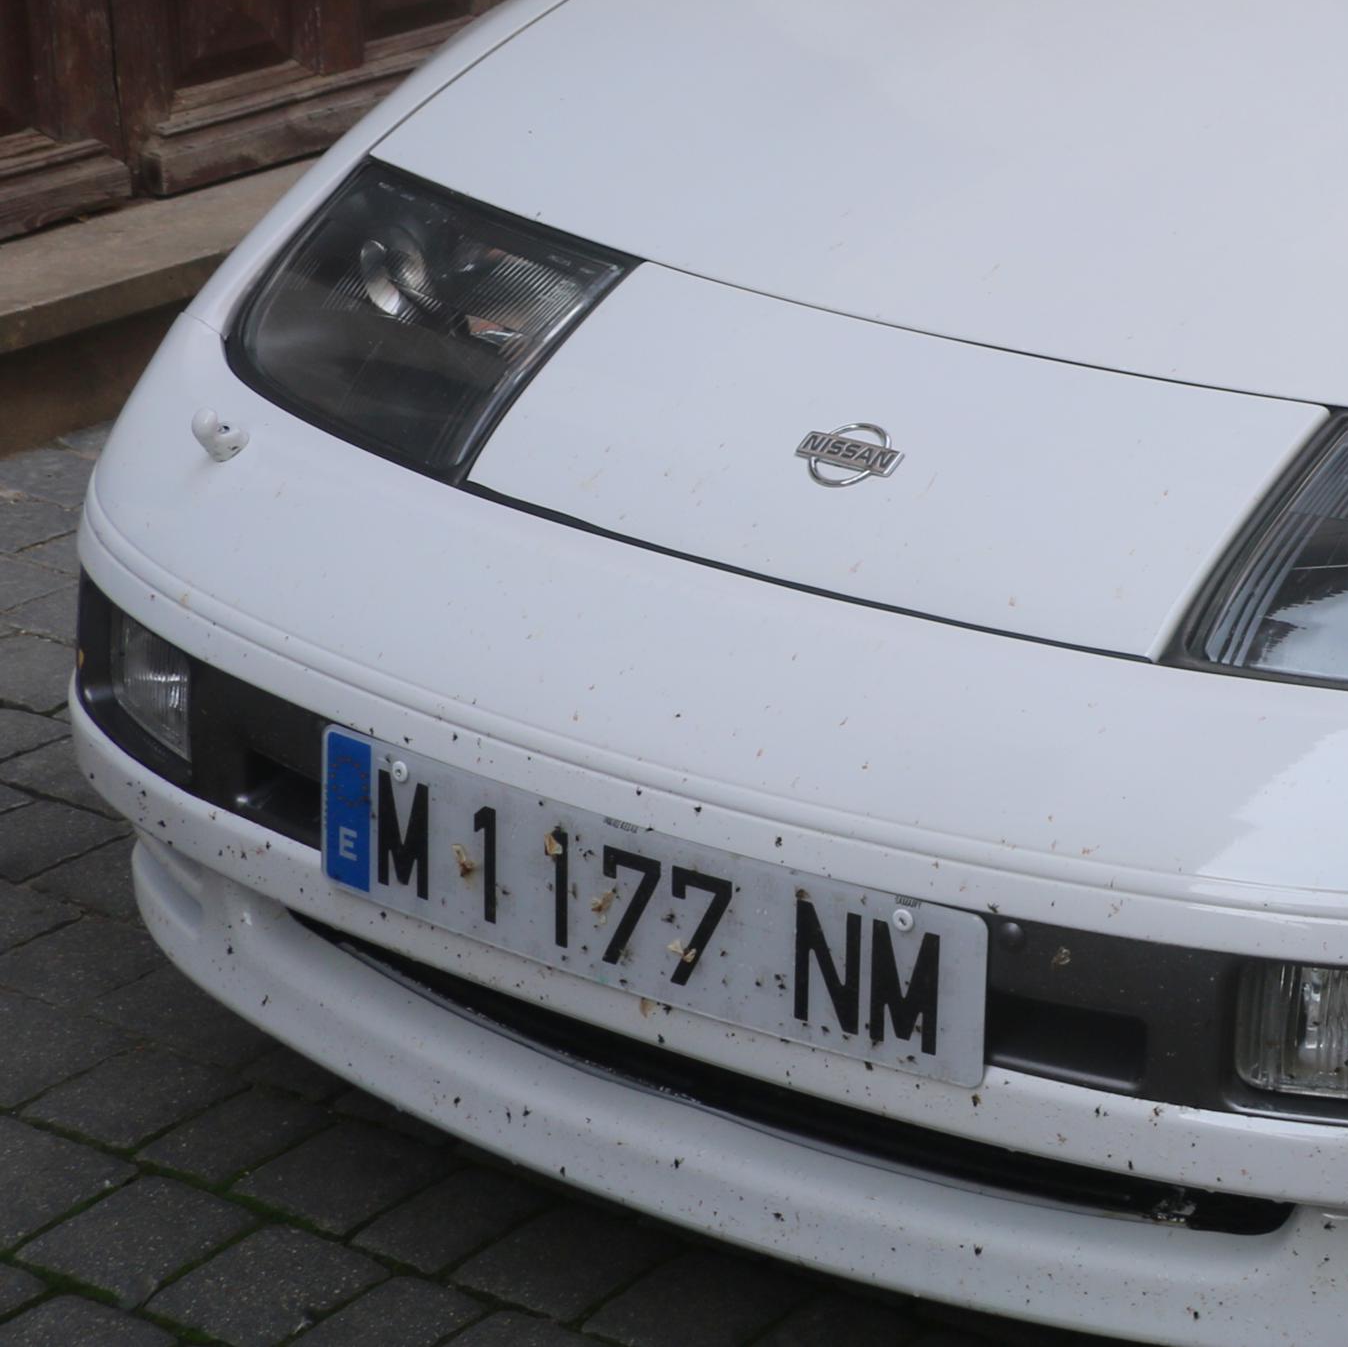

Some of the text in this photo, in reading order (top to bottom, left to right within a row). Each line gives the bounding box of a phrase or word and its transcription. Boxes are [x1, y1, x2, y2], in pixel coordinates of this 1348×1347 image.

[801, 434, 897, 469] NISSAN
[339, 826, 358, 862] E
[377, 768, 941, 1056] M 1177 NM
